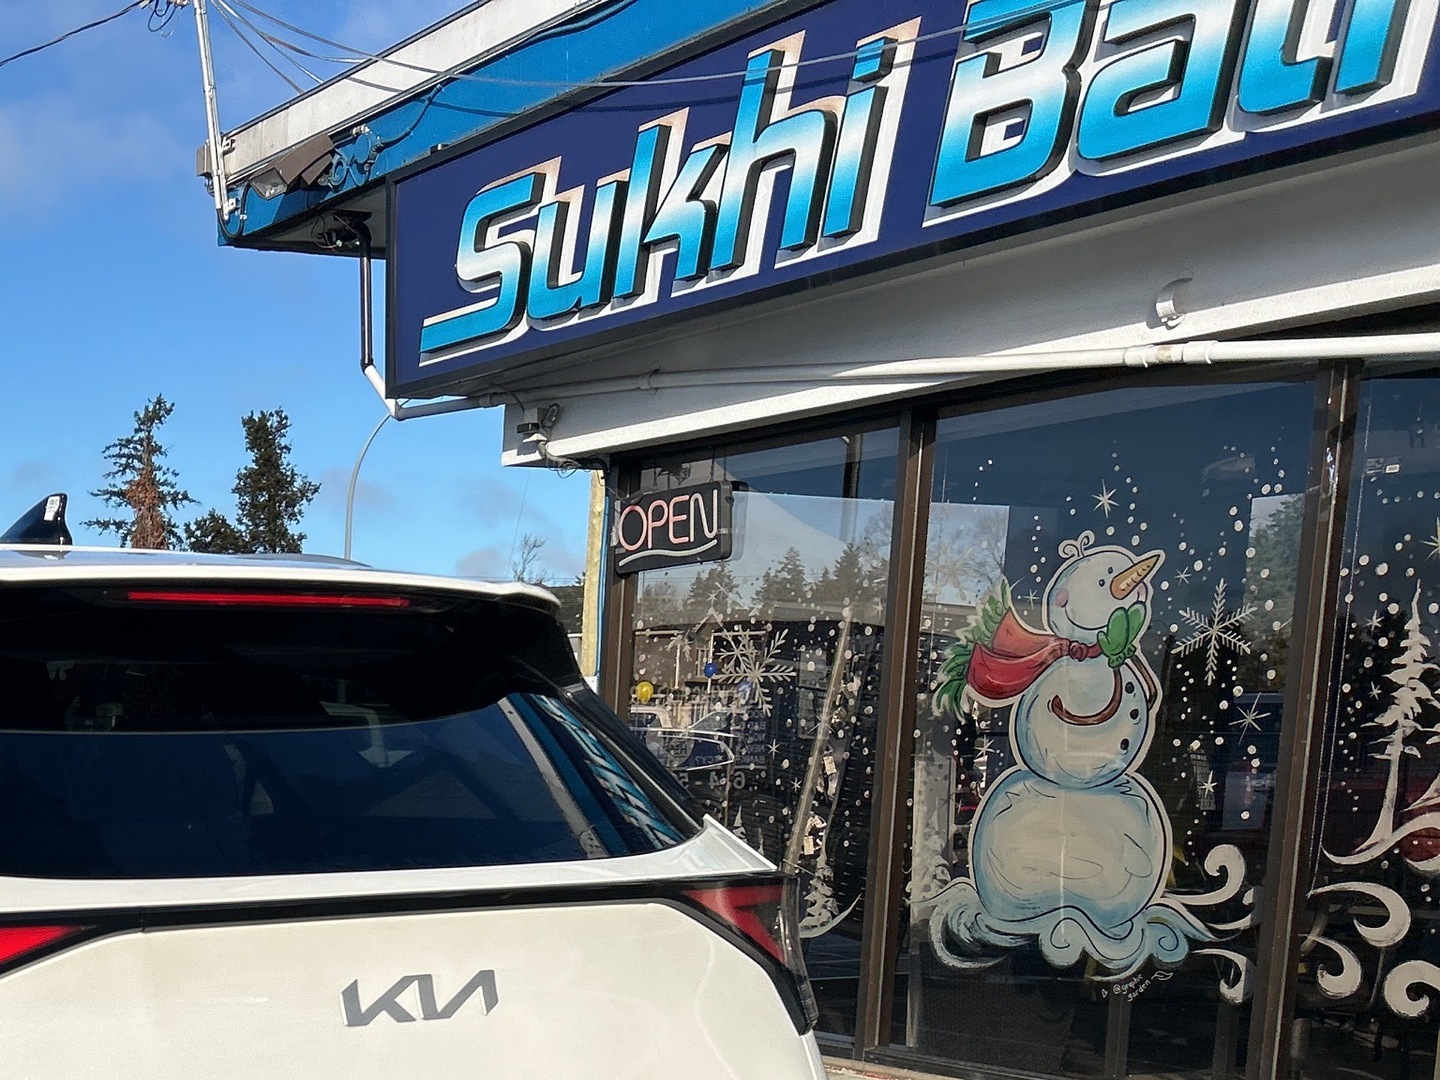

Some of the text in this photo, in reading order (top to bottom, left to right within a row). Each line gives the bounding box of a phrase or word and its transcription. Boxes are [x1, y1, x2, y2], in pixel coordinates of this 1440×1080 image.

[419, 30, 908, 358] Sukhi
[618, 489, 718, 551] OPEN
[340, 969, 499, 1027] KIA
